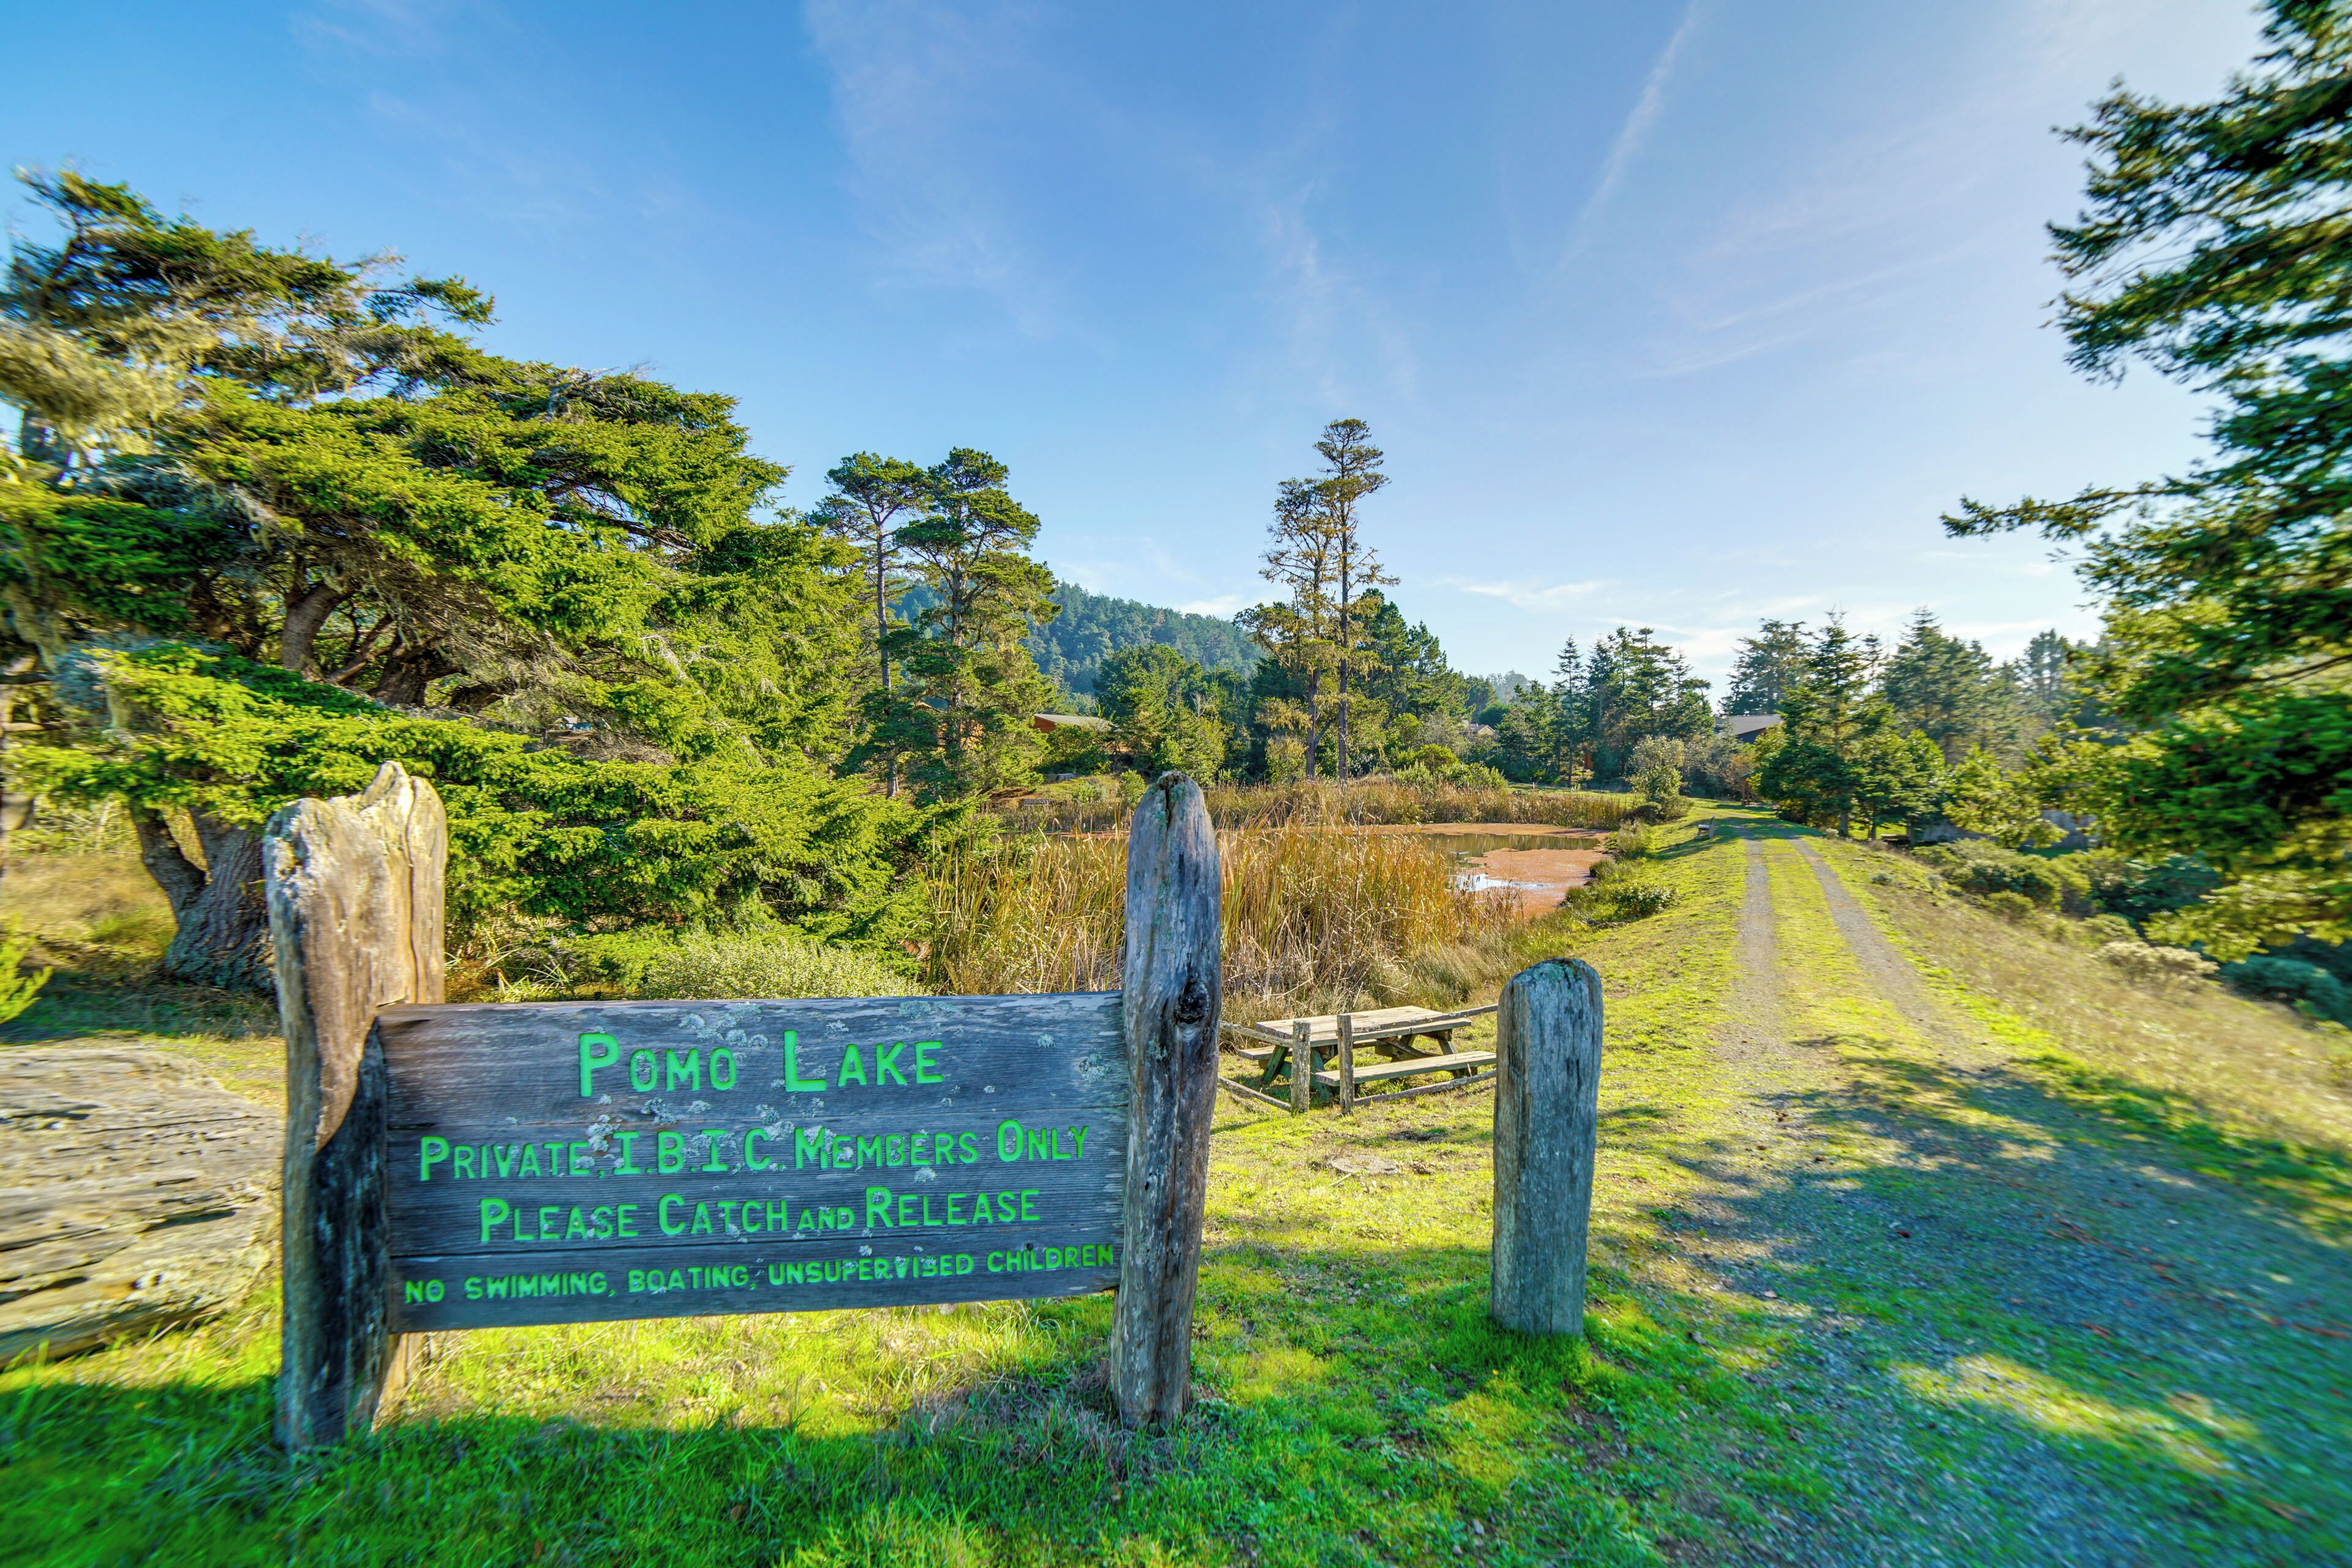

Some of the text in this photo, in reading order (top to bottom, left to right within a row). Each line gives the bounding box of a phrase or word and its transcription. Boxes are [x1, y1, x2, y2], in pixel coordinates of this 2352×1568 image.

[579, 1030, 944, 1097] POMO LAKE
[420, 1129, 605, 1181] PRIVATE,
[794, 1127, 979, 1169] MEMBERS
[997, 1119, 1089, 1162] ONLY
[480, 1186, 1041, 1242] PLEASE CATCH AND RELEASE
[405, 1244, 1114, 1303] NO SWIMMING, BOATING, UNSUPERVISED CHILDREN
